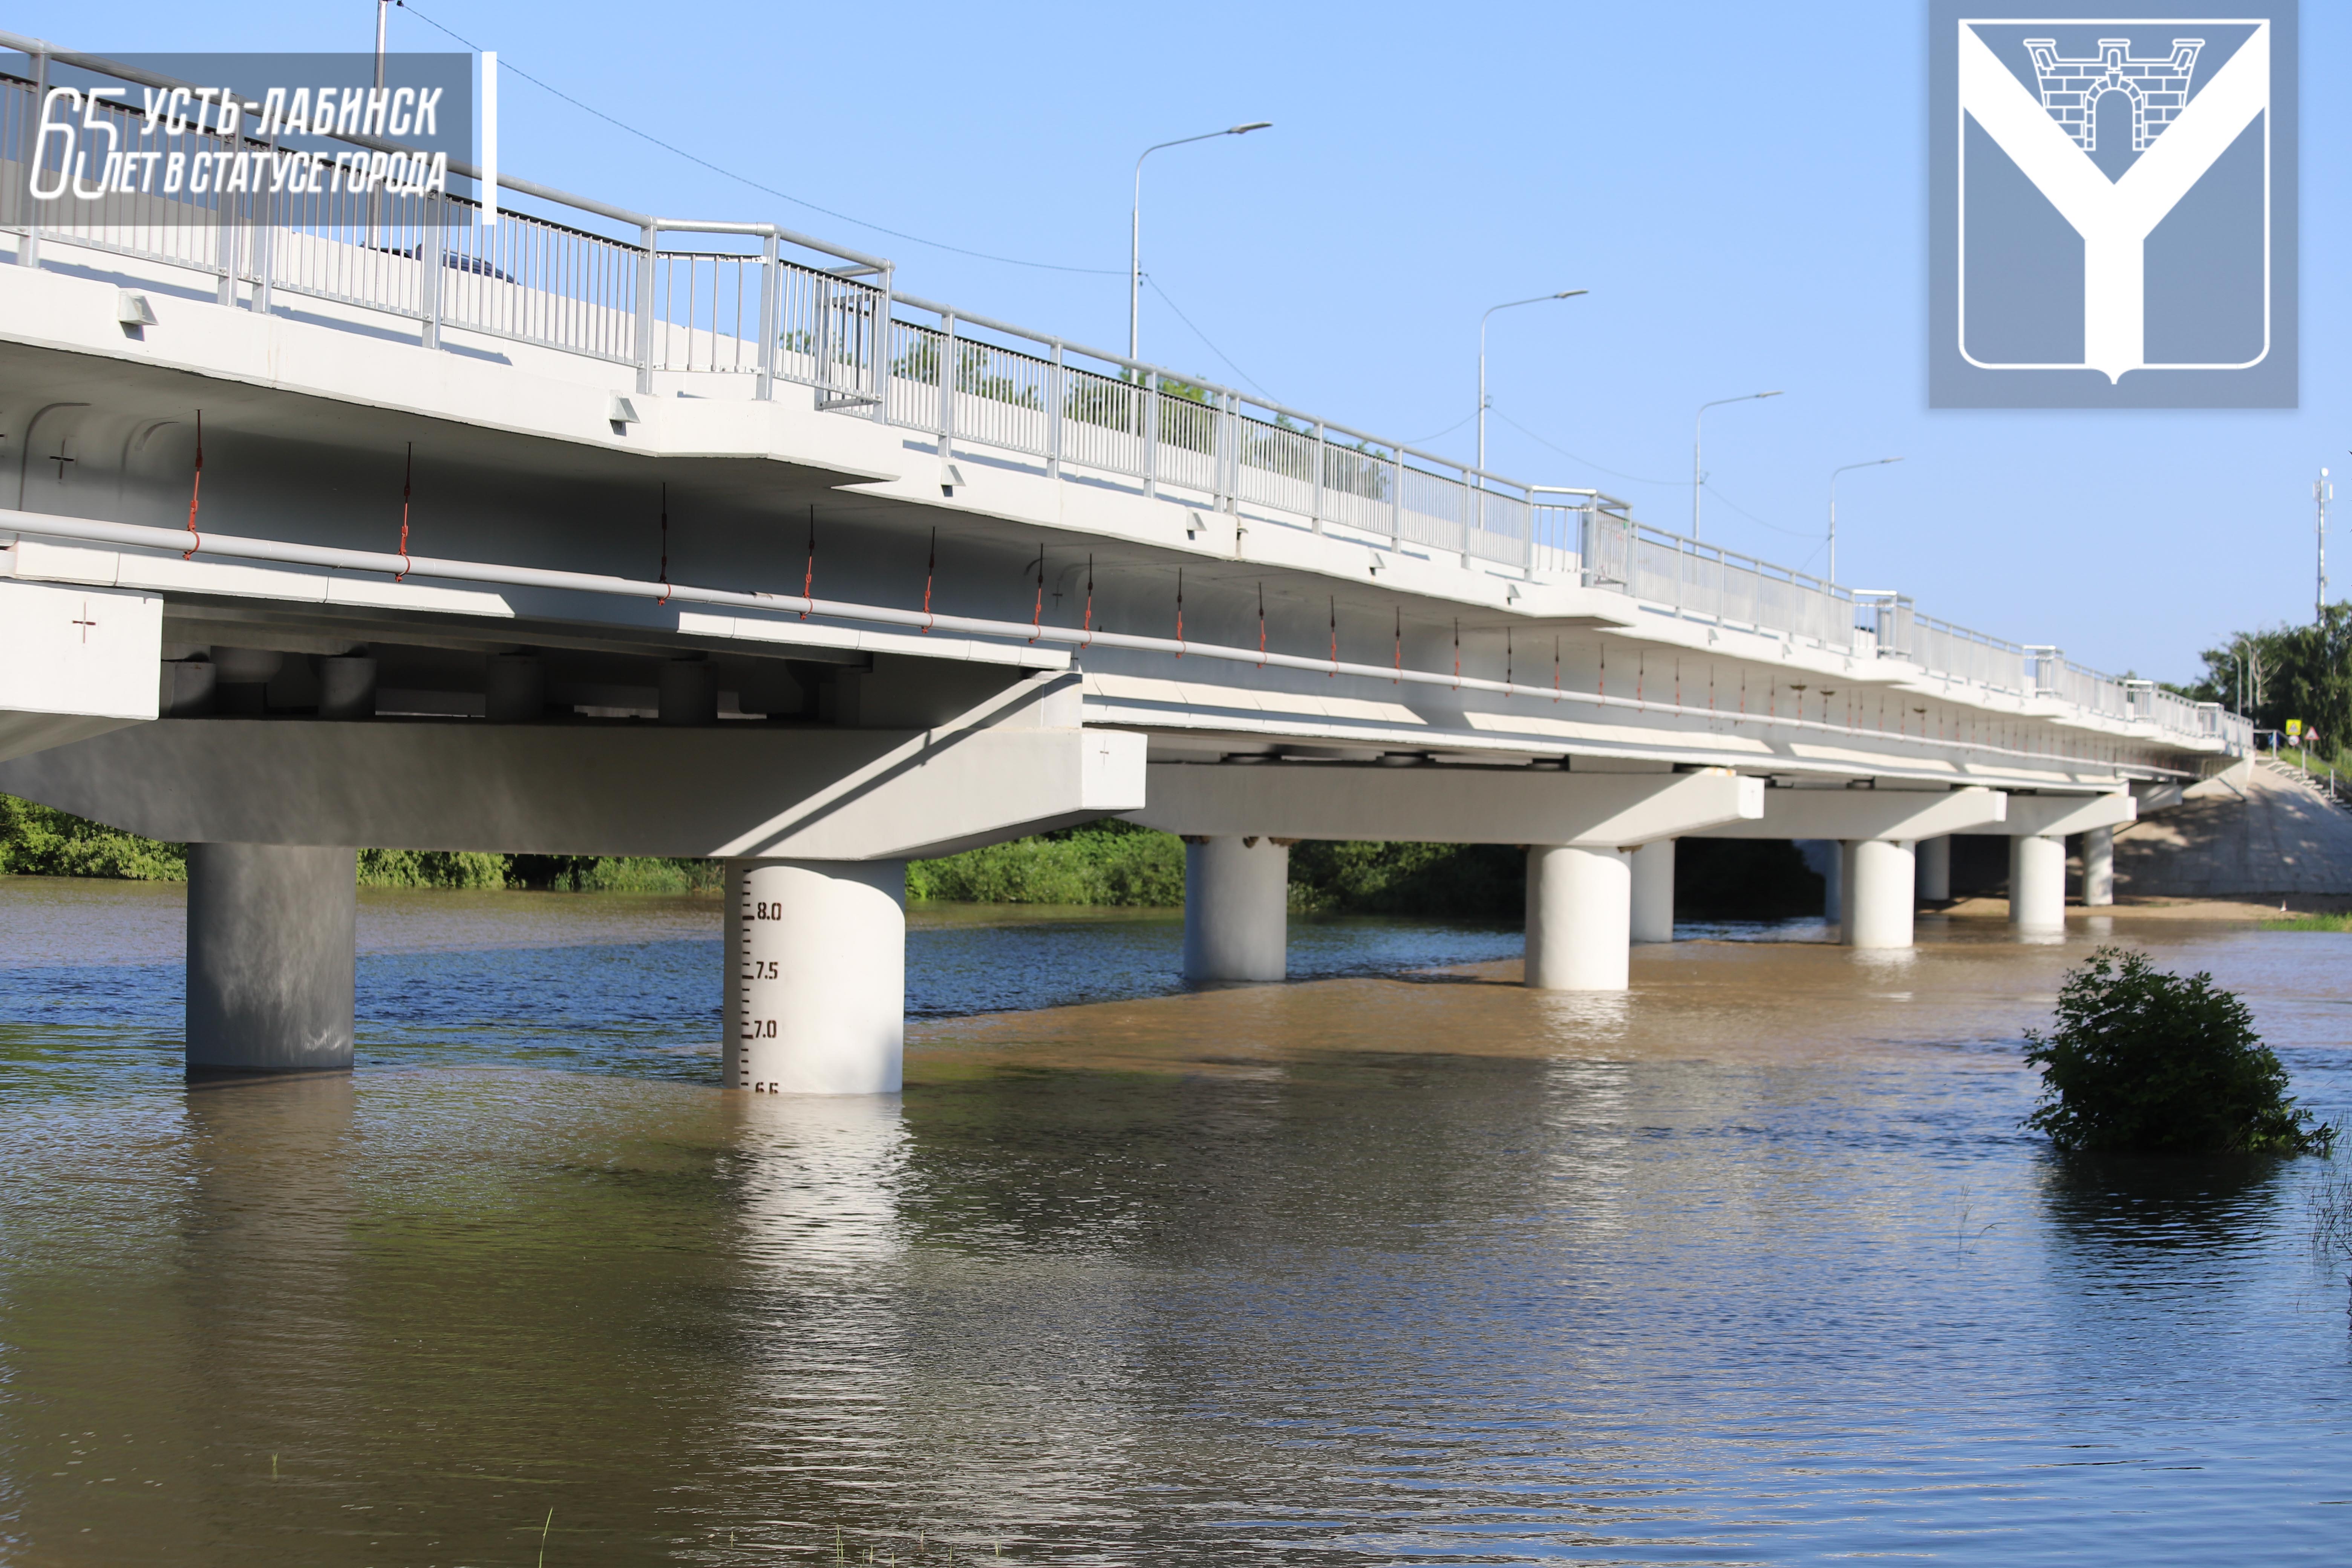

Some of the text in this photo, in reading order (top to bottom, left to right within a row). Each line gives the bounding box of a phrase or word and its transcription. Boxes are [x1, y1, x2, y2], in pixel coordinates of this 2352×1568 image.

[757, 902, 781, 921] 8.0
[756, 961, 778, 980] 7.5
[754, 1020, 776, 1038] 7.0
[755, 1082, 778, 1094] 65
